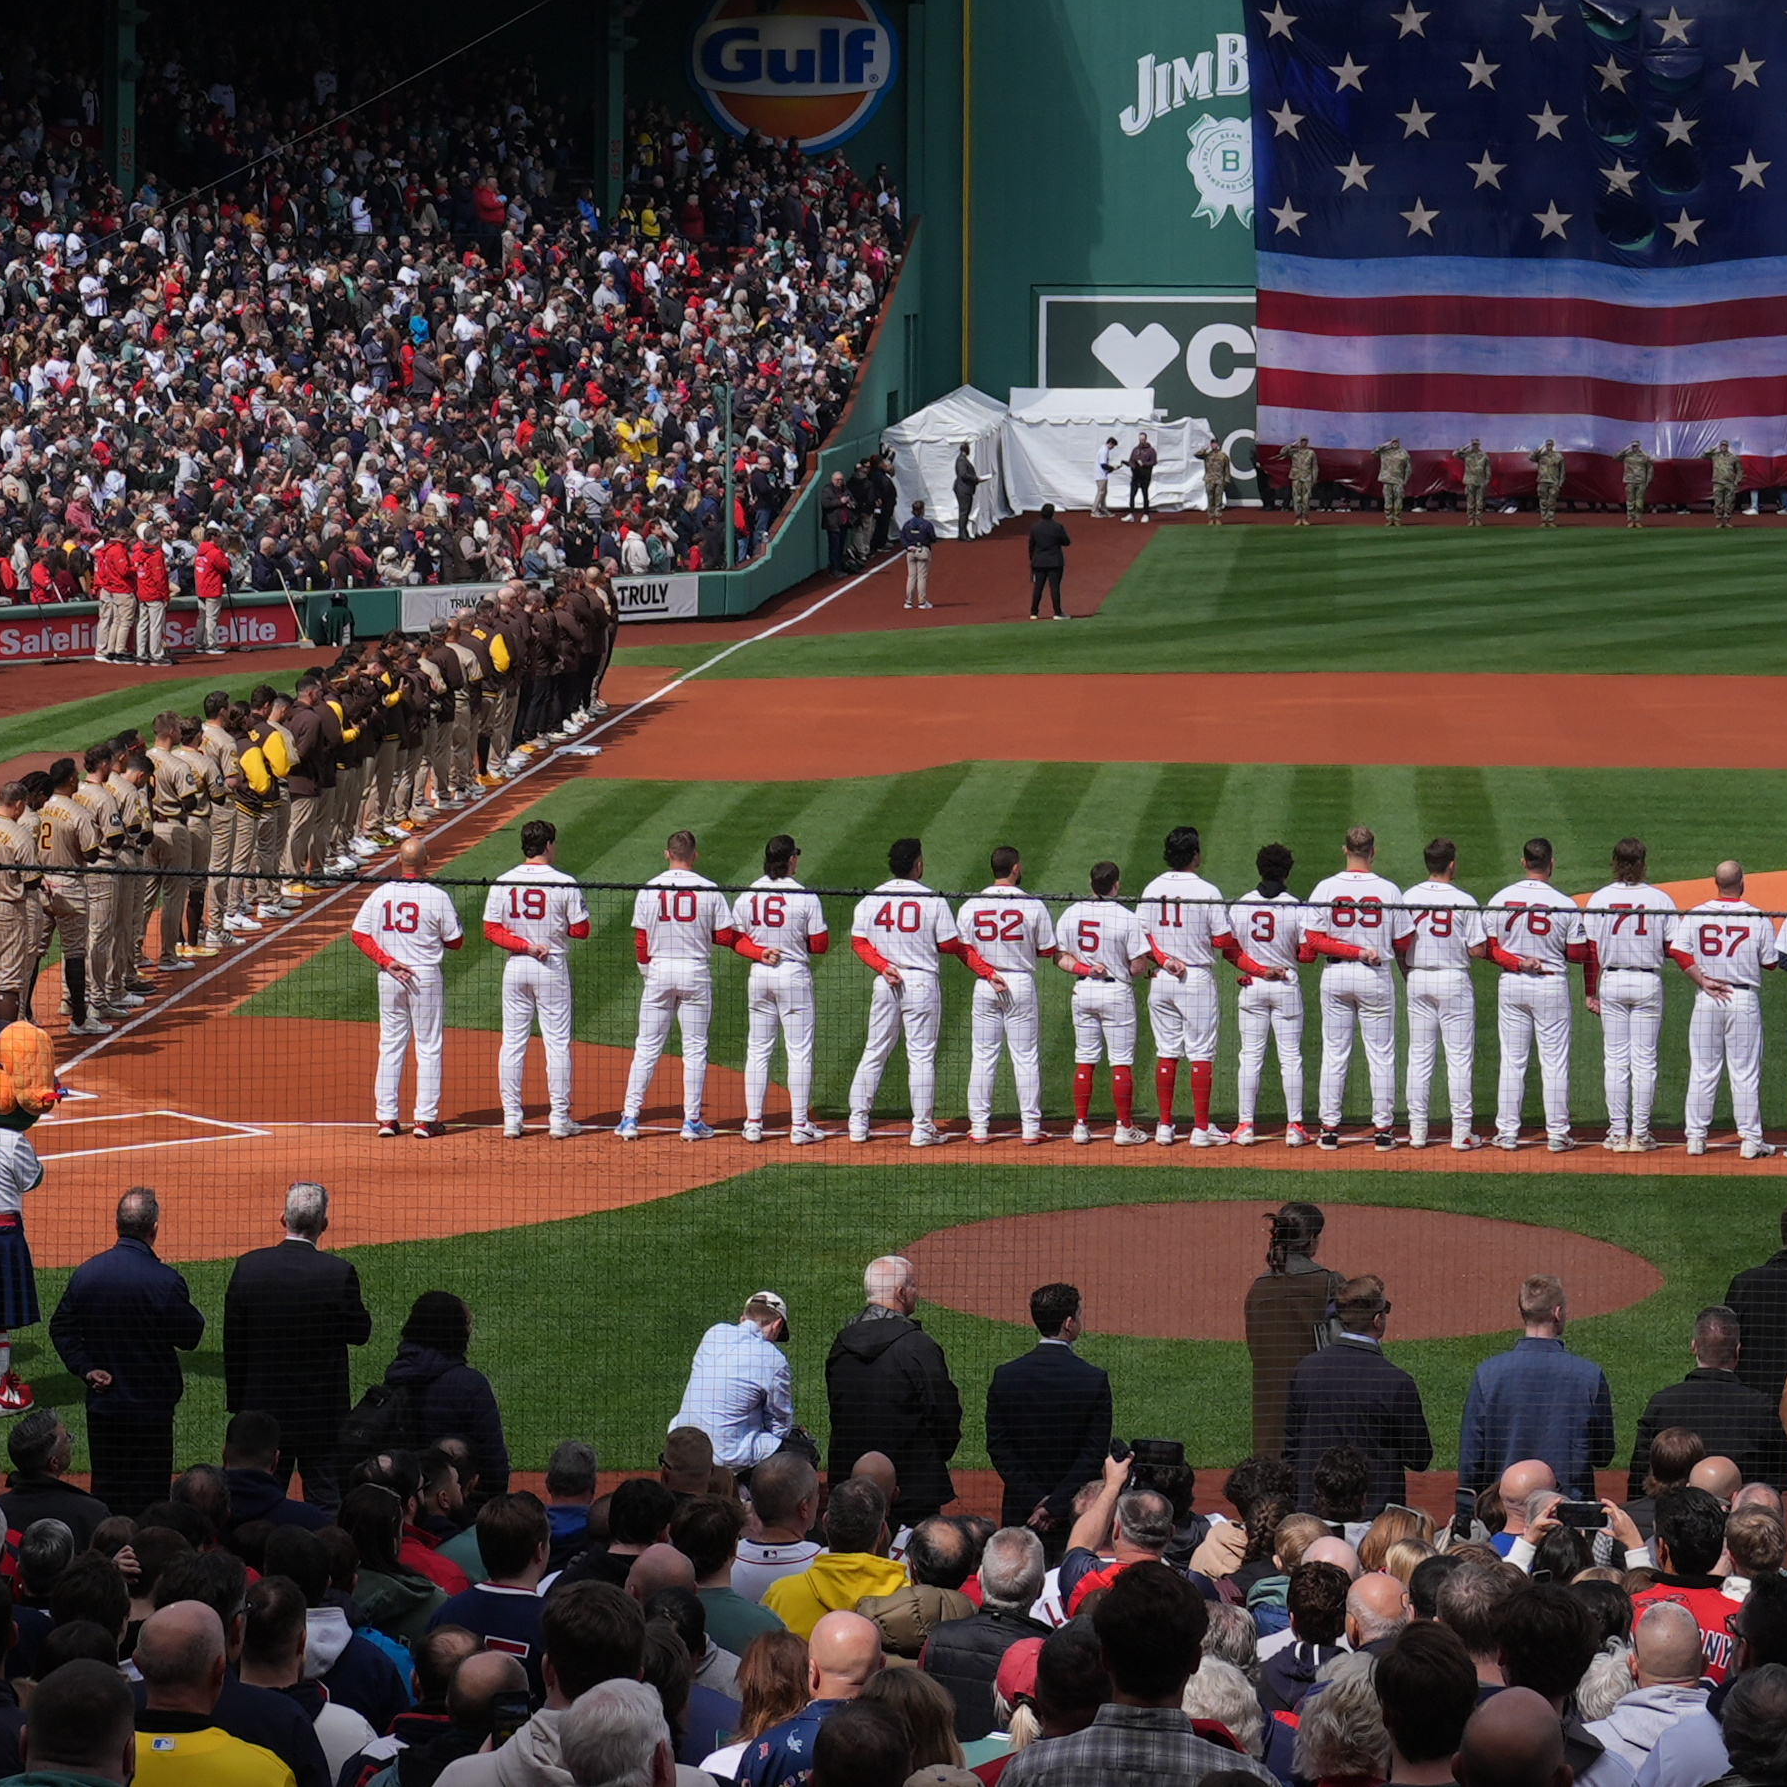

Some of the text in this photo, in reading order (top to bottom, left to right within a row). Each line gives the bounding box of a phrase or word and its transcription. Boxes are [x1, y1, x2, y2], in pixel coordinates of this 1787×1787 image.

[701, 27, 877, 84] Gulf
[1118, 51, 1214, 137] JIM
[1221, 149, 1240, 172] B
[1186, 323, 1257, 398] C
[449, 597, 477, 610] TRULY
[618, 583, 669, 607] TRULY
[164, 616, 277, 647] Saelite
[381, 899, 420, 933] 13
[508, 887, 546, 920] 19
[657, 889, 698, 923] 10
[749, 895, 785, 928] 16
[874, 900, 921, 934] 40
[1157, 896, 1184, 927] 11
[1330, 895, 1384, 929] 69
[1503, 900, 1552, 937] 76
[1609, 902, 1647, 936] 71
[973, 908, 1024, 941] 52
[1077, 920, 1100, 953] 5
[1251, 909, 1275, 943] 3
[1698, 924, 1751, 958] 67
